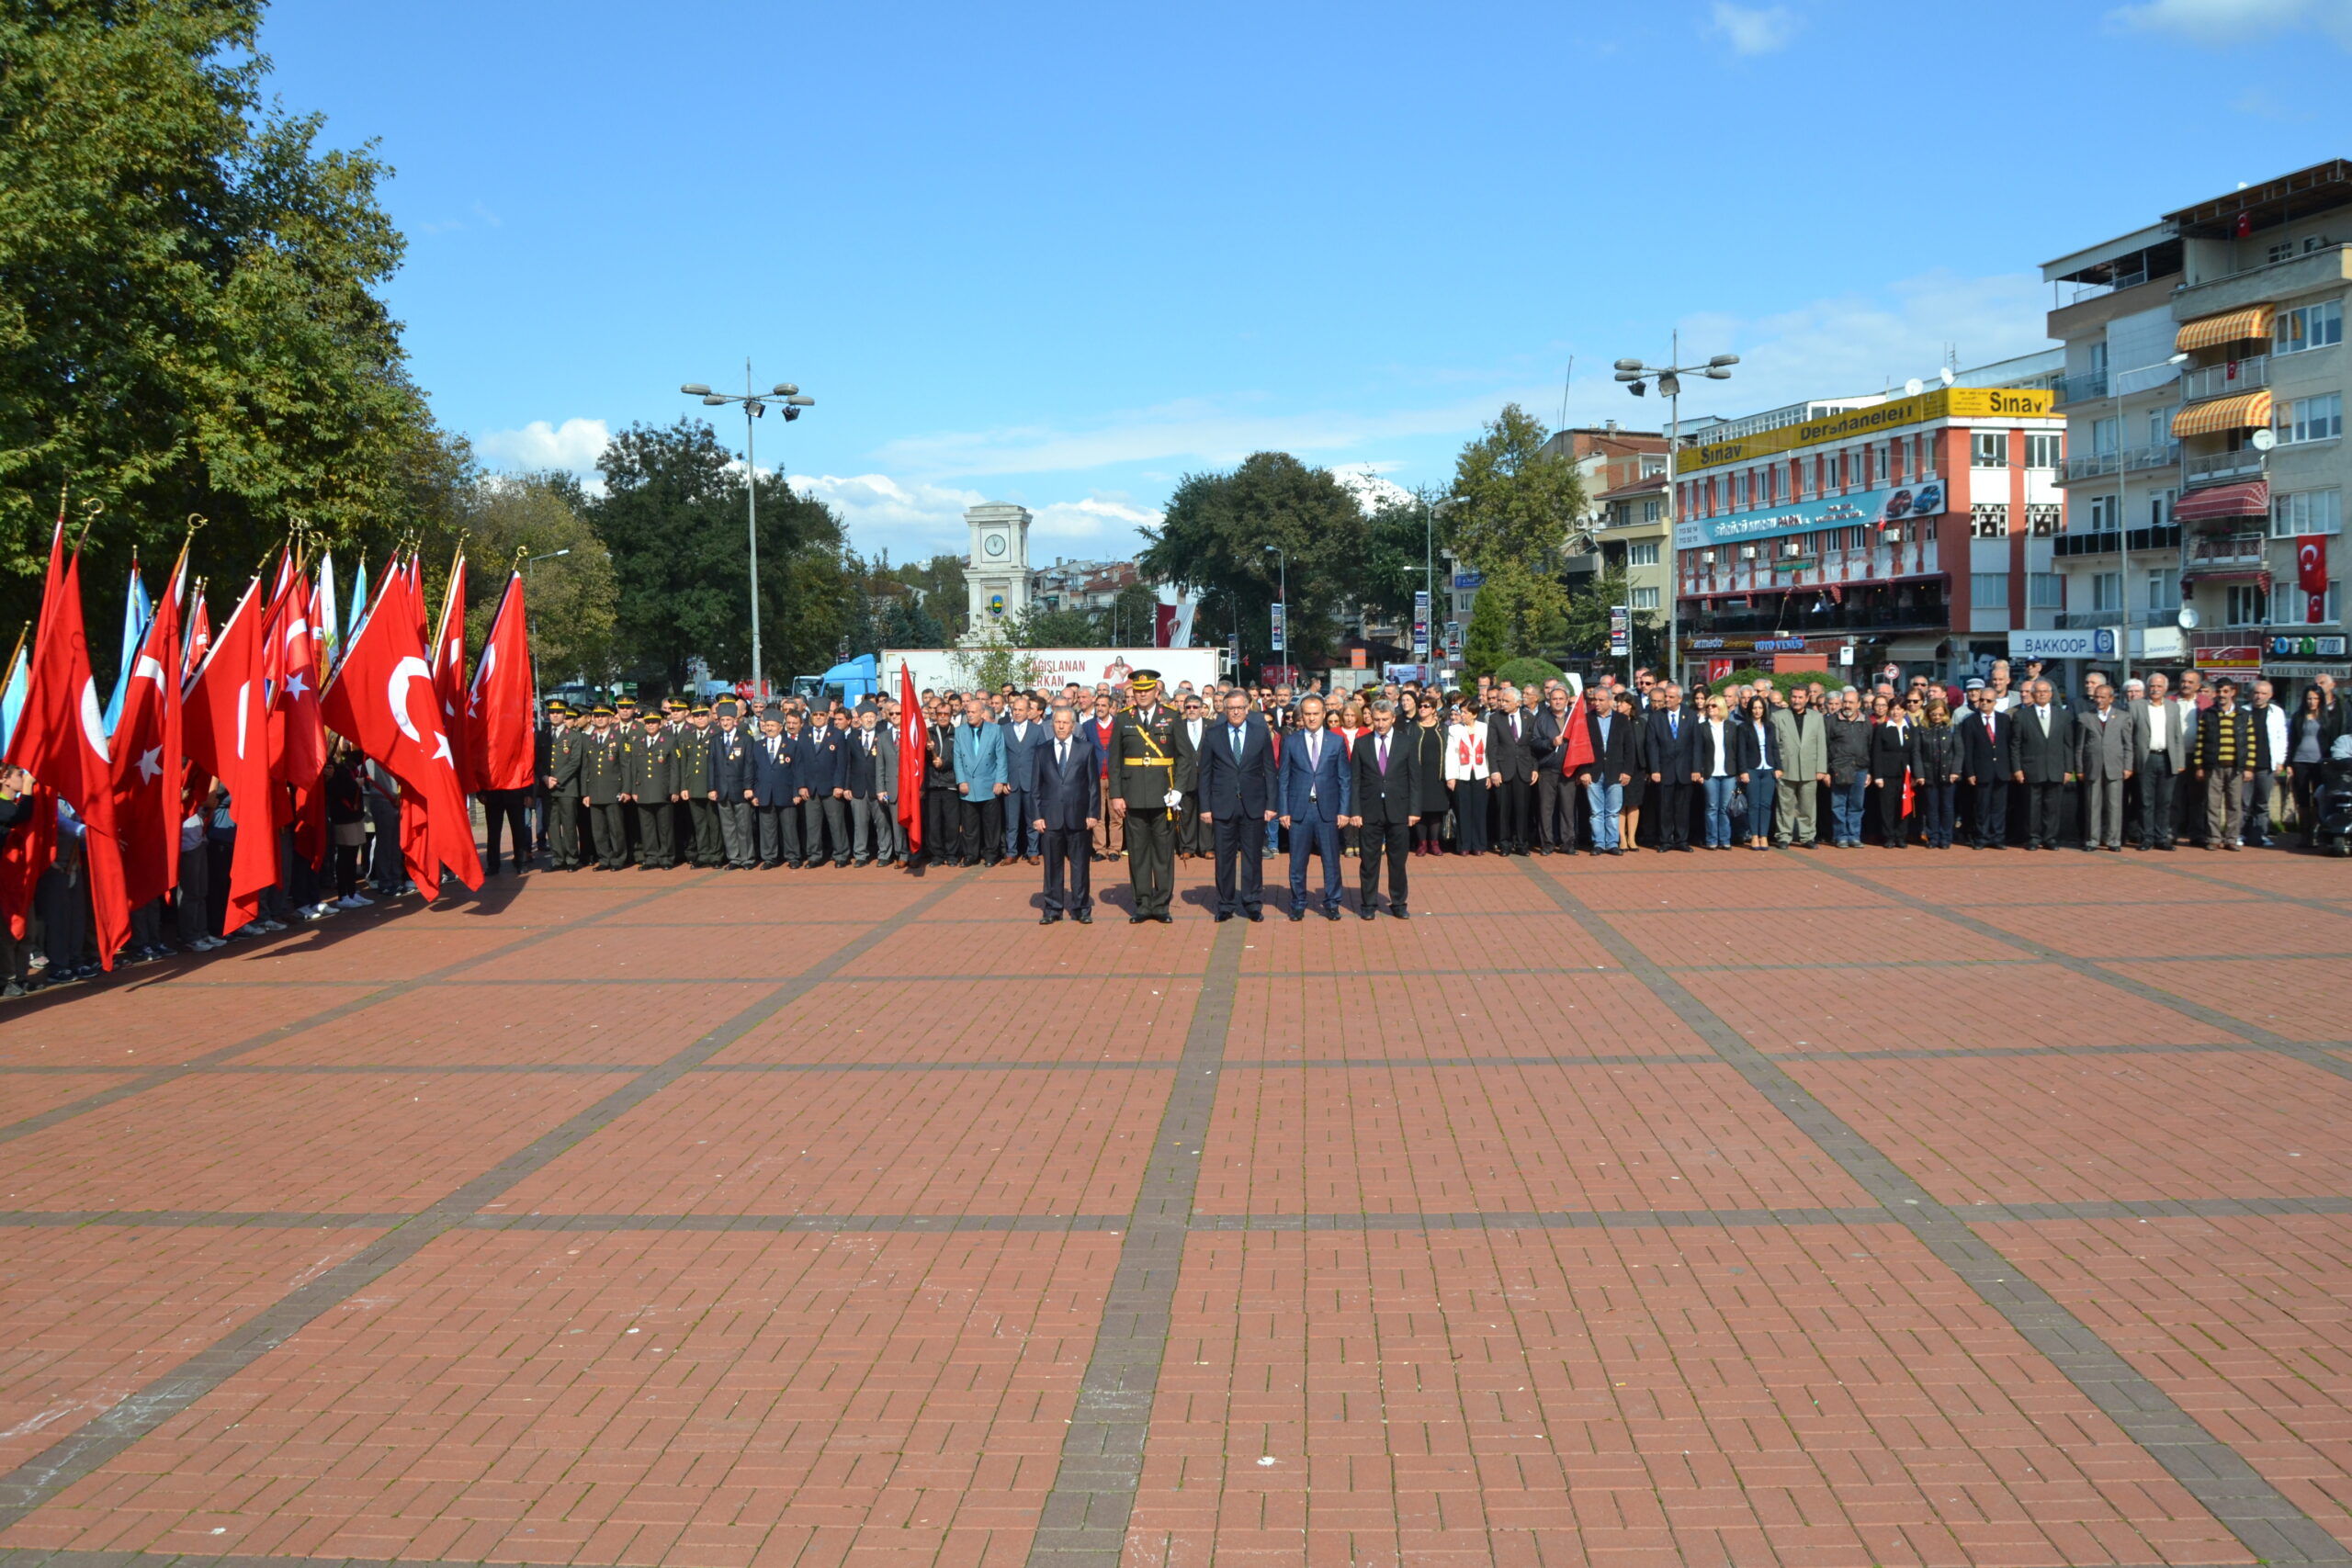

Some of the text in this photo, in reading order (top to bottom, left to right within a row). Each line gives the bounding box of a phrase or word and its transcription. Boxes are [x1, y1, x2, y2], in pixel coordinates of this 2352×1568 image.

[1990, 391, 2042, 412] Sınav
[1701, 445, 1742, 465] Sınav
[2025, 638, 2086, 653] BAKKOOP
[2264, 636, 2316, 654] FOTO
